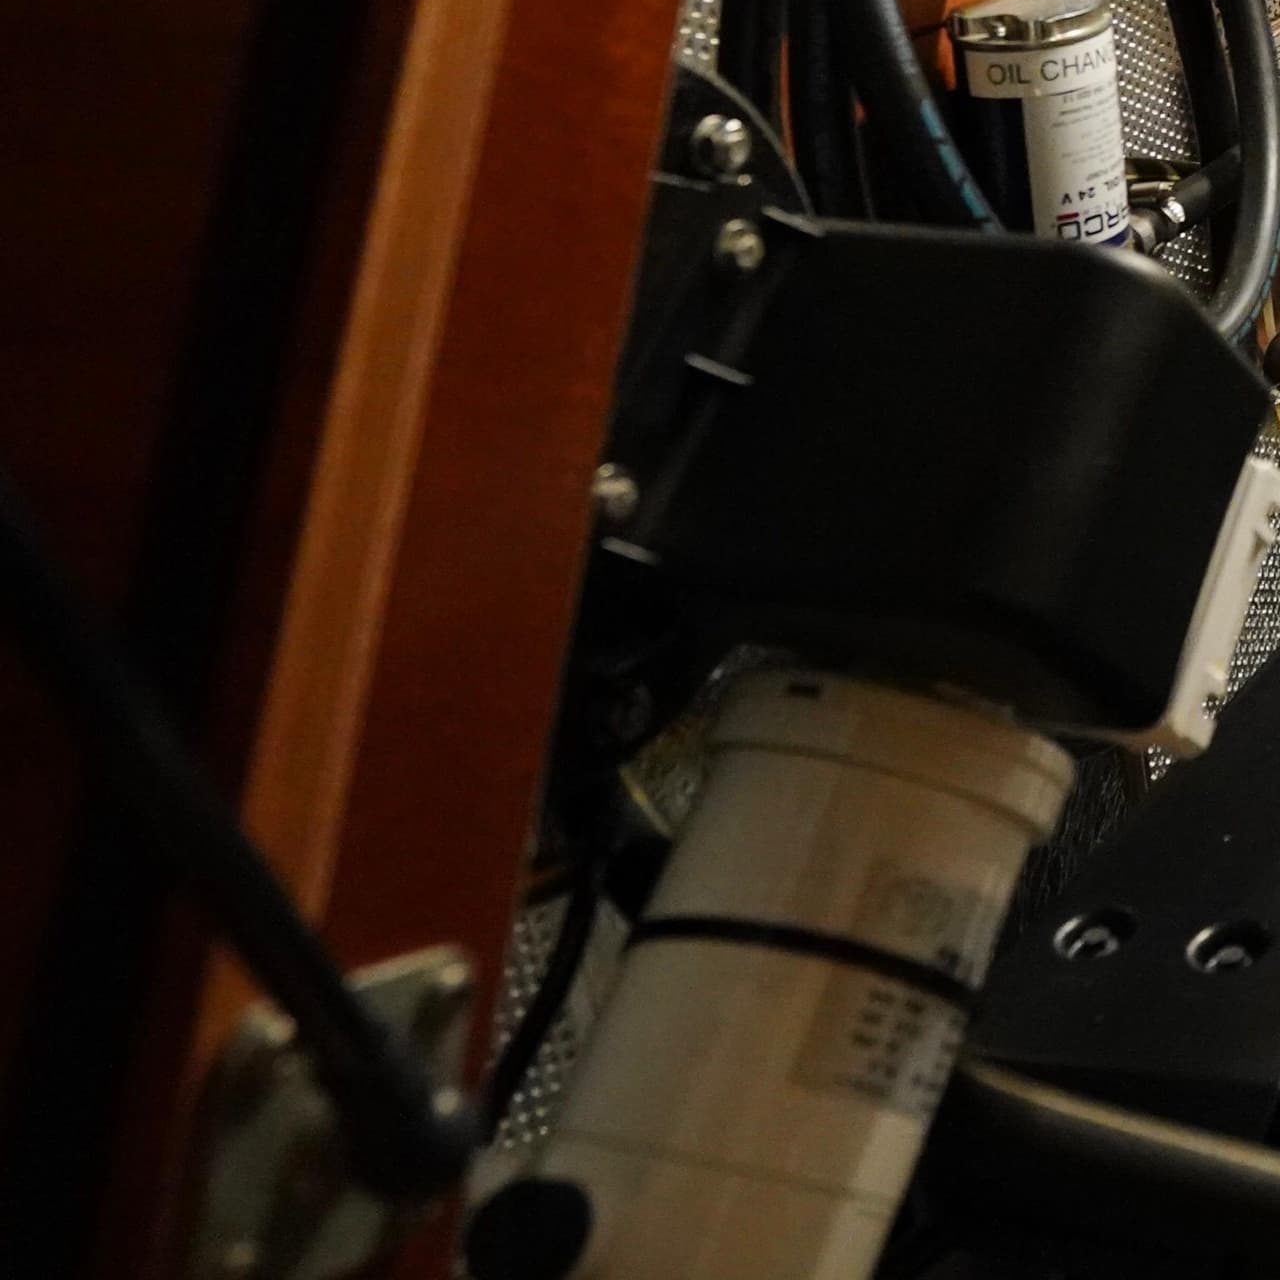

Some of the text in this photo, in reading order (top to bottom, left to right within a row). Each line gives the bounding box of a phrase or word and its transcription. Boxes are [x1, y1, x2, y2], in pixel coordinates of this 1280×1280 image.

[986, 47, 1113, 86] OIL CHAN
[1061, 192, 1073, 205] V
[1078, 186, 1096, 201] 24
